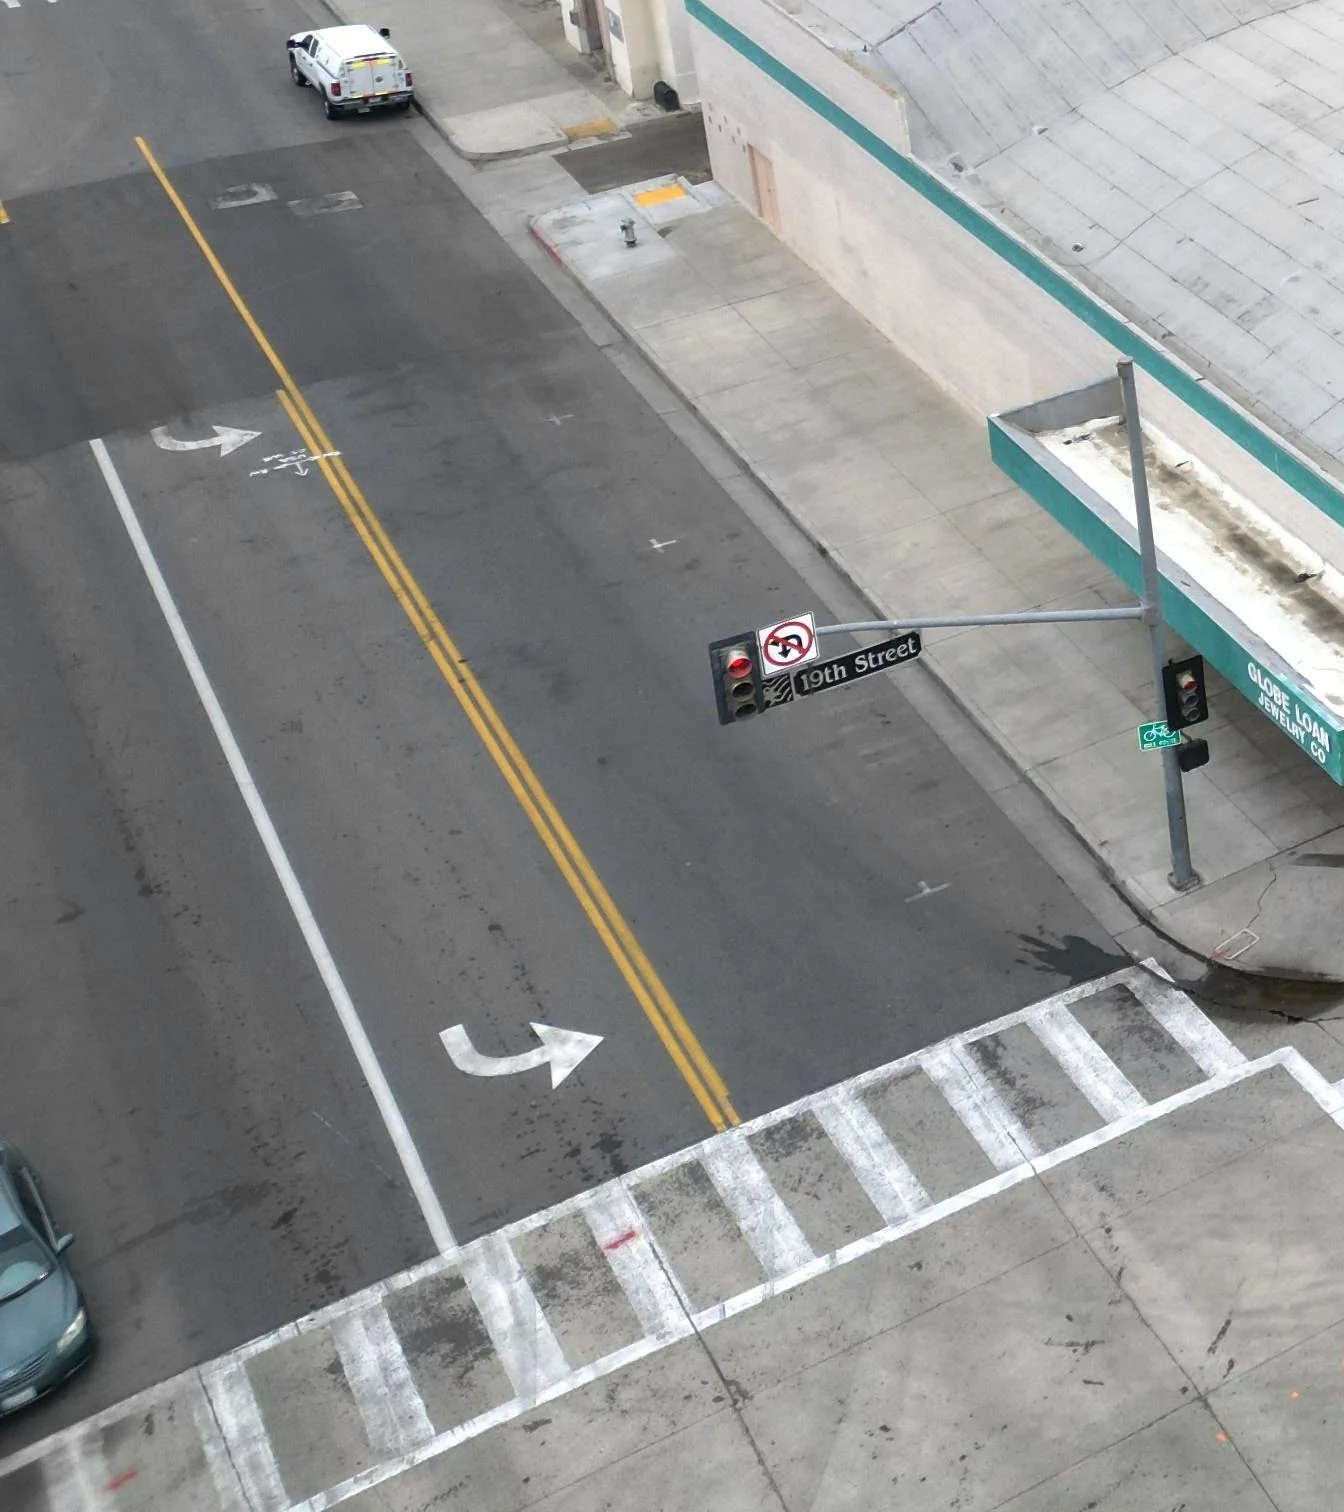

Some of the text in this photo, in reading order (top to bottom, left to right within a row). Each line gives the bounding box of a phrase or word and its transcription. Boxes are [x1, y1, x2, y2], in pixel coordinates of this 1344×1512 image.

[800, 638, 917, 691] 19th Street
[1247, 662, 1331, 753] GLOBE LOAN
[1258, 691, 1326, 764] JEWELRY CO
